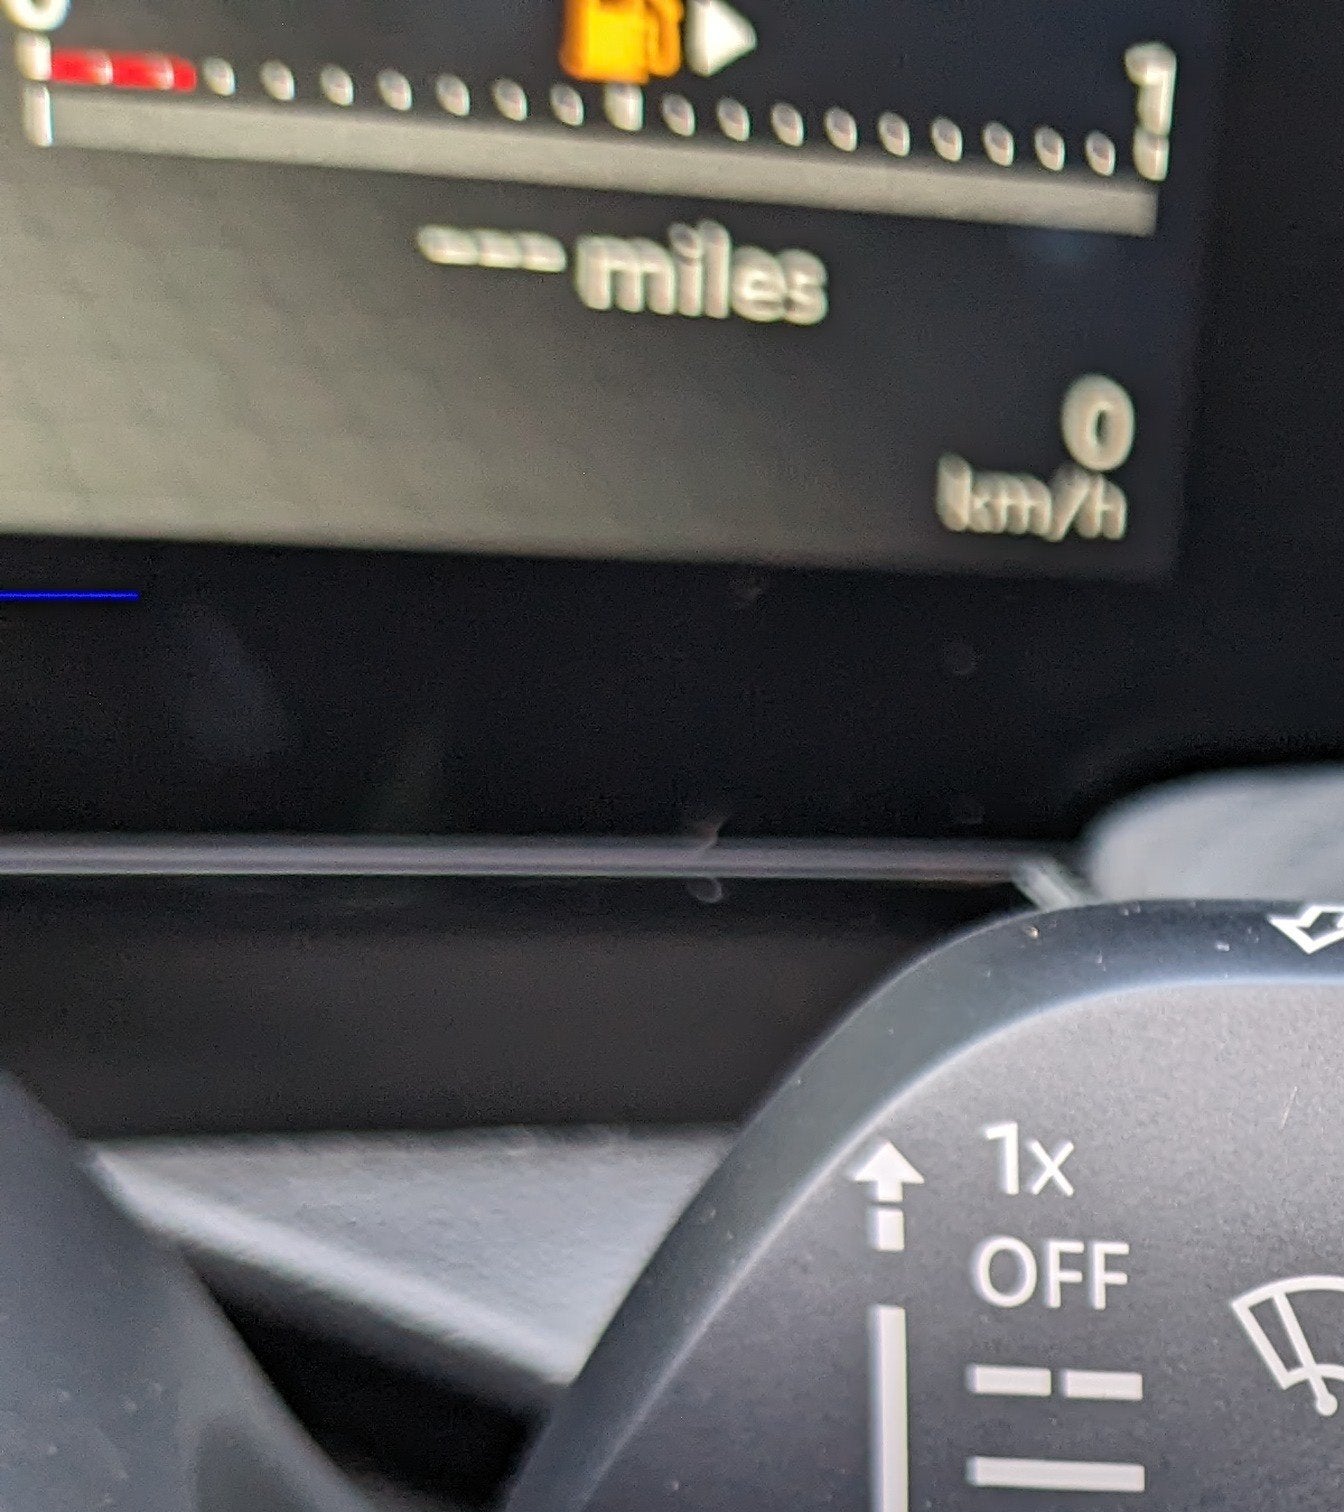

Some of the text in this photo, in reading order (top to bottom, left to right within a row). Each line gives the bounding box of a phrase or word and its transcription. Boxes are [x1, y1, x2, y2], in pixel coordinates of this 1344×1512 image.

[574, 218, 830, 326] miles
[1061, 372, 1136, 472] 0
[935, 450, 1128, 543] km/h
[982, 1121, 1075, 1197] 1x
[971, 1235, 1130, 1311] OFF
